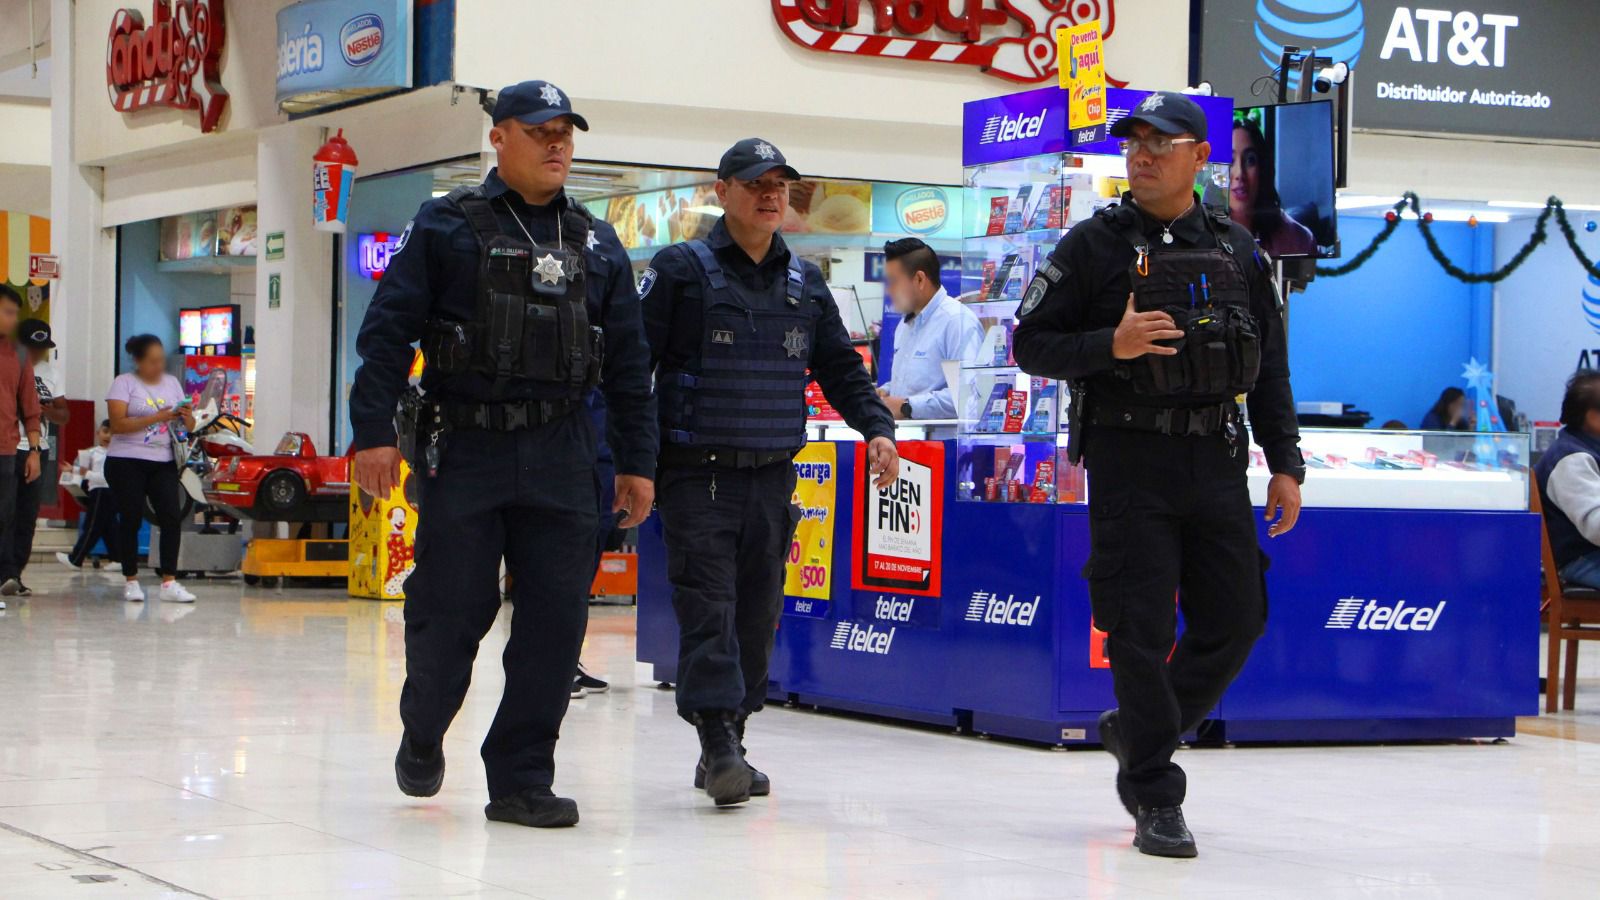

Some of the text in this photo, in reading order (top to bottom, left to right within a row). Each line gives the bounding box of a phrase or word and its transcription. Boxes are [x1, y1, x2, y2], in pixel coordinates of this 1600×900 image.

[346, 32, 381, 57] Nestlé
[1071, 29, 1098, 46] De venta
[1379, 6, 1519, 68] AT&T
[1078, 45, 1100, 71] aquí
[1376, 82, 1551, 109] Distribuidor Autorizado
[1088, 103, 1101, 116] Chip
[997, 108, 1047, 142] telcel
[1077, 127, 1096, 144] telcel
[905, 205, 945, 225] Nestlé
[801, 565, 826, 589] $500
[897, 564, 922, 573] NOVIEMBRE
[795, 600, 812, 613] telcel
[876, 595, 914, 622] telcel
[984, 593, 1041, 627] telcel
[1357, 599, 1446, 631] telcel
[847, 623, 896, 655] telcel
